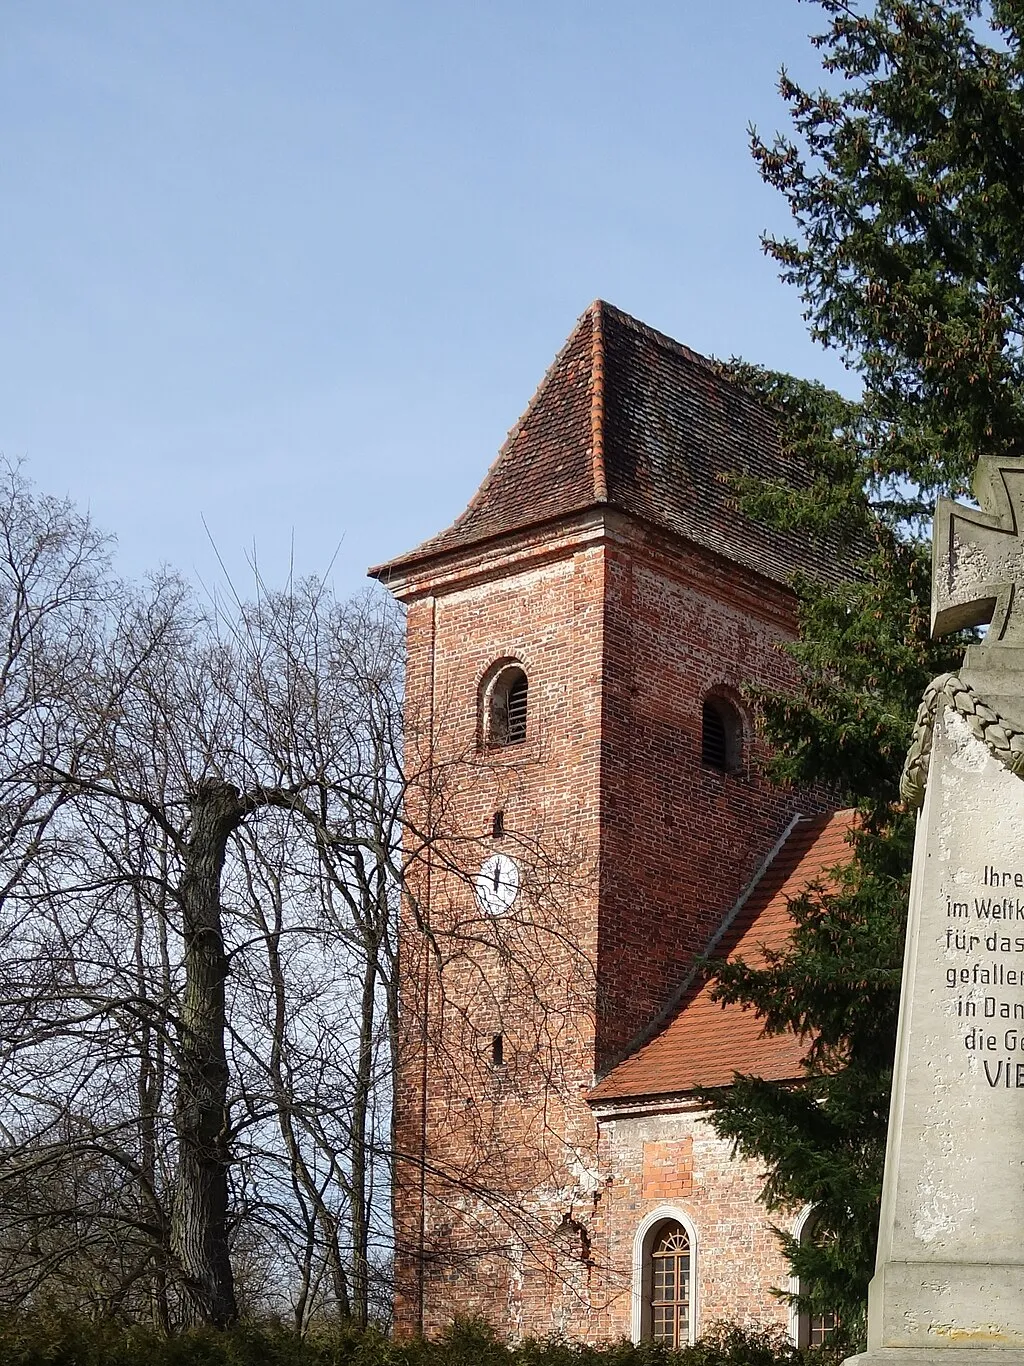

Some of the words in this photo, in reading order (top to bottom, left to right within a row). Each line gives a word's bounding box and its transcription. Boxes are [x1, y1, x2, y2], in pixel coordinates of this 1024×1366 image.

[947, 896, 968, 917] im
[946, 929, 980, 953] für
[986, 933, 1024, 952] das
[958, 996, 975, 1016] in
[965, 1029, 996, 1050] die
